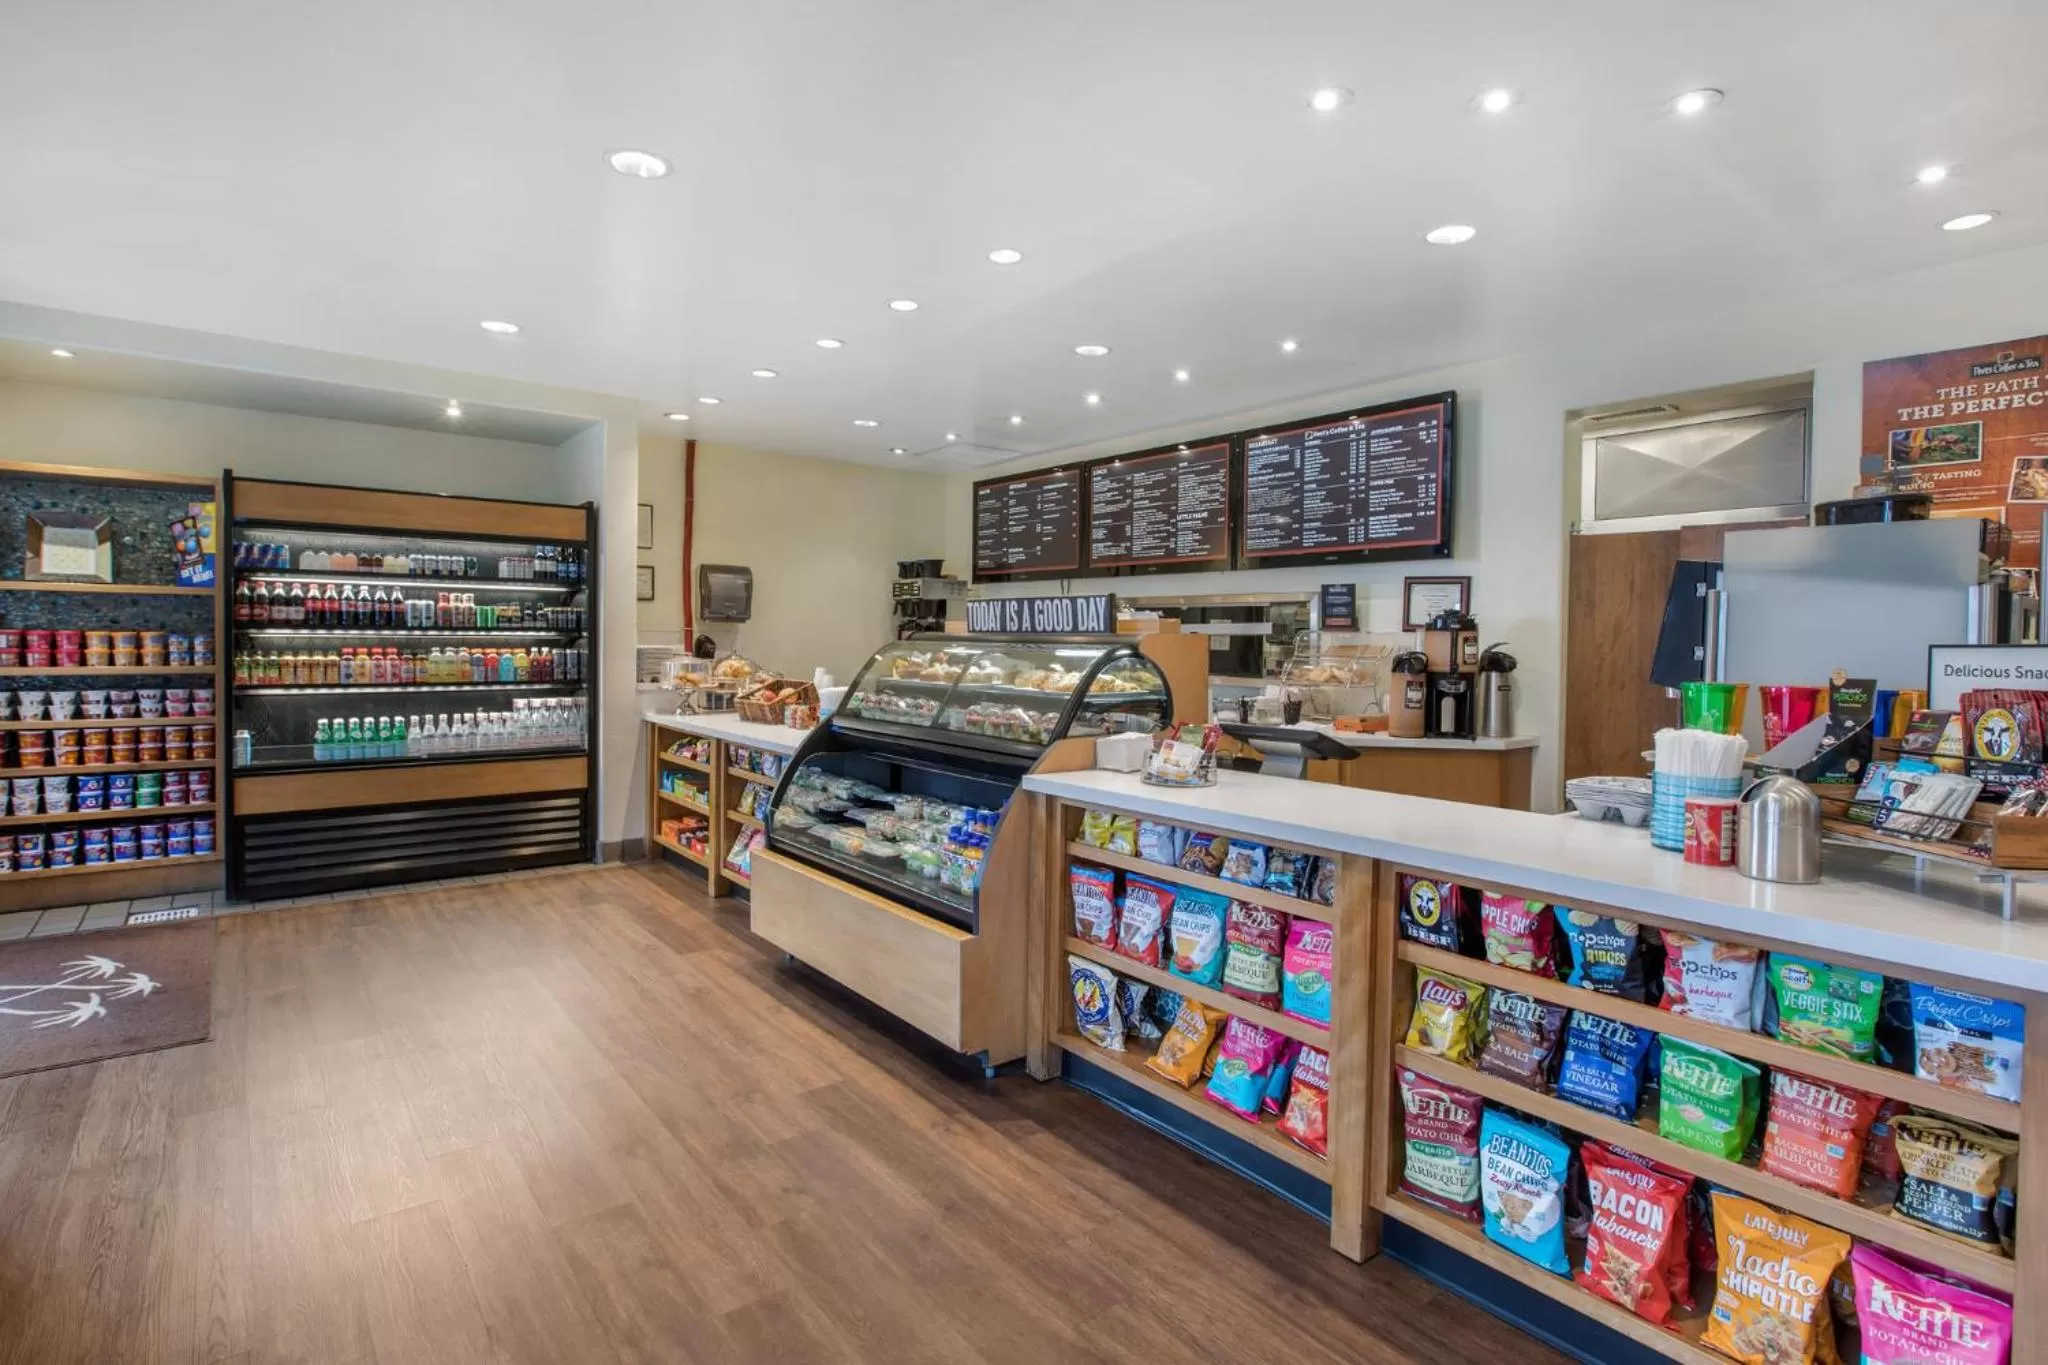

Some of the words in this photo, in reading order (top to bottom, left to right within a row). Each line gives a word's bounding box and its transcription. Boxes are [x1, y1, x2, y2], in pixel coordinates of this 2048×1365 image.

[1936, 384, 1978, 400] THE
[1983, 376, 2039, 396] PATH
[1897, 403, 1945, 421] THE
[1932, 469, 1982, 481] TASTING
[967, 600, 1001, 632] TODAY
[1006, 600, 1020, 632] IS
[1022, 601, 1032, 631] A
[1034, 598, 1073, 632] GOOD
[1077, 597, 1106, 632] DAY
[1944, 664, 2010, 678] Delicious
[1586, 949, 1627, 966] RIDGES
[1421, 980, 1467, 1006] Lay's
[1782, 989, 1828, 1014] VEGGIE
[1832, 1000, 1864, 1022] STIX
[1504, 1047, 1530, 1063] SALT
[1565, 1070, 1620, 1094] VINEGAR
[1401, 1084, 1477, 1128] KETTLE
[1418, 1118, 1449, 1130] BRAND
[1487, 1157, 1514, 1179] BEAN
[1489, 1134, 1553, 1179] BEANITOS
[1489, 1173, 1514, 1191] Zesty
[1514, 1181, 1543, 1198] Ranch
[1910, 1179, 1949, 1199] SALT
[1950, 1193, 1960, 1202] &
[1589, 1179, 1664, 1233] BACON
[1905, 1195, 1965, 1223] PEPPER
[1728, 1233, 1821, 1297] Nacho
[1866, 1276, 1989, 1349] KETTLE
[1869, 1325, 1931, 1357] POTATO
[1903, 1327, 1949, 1349] BRAND
